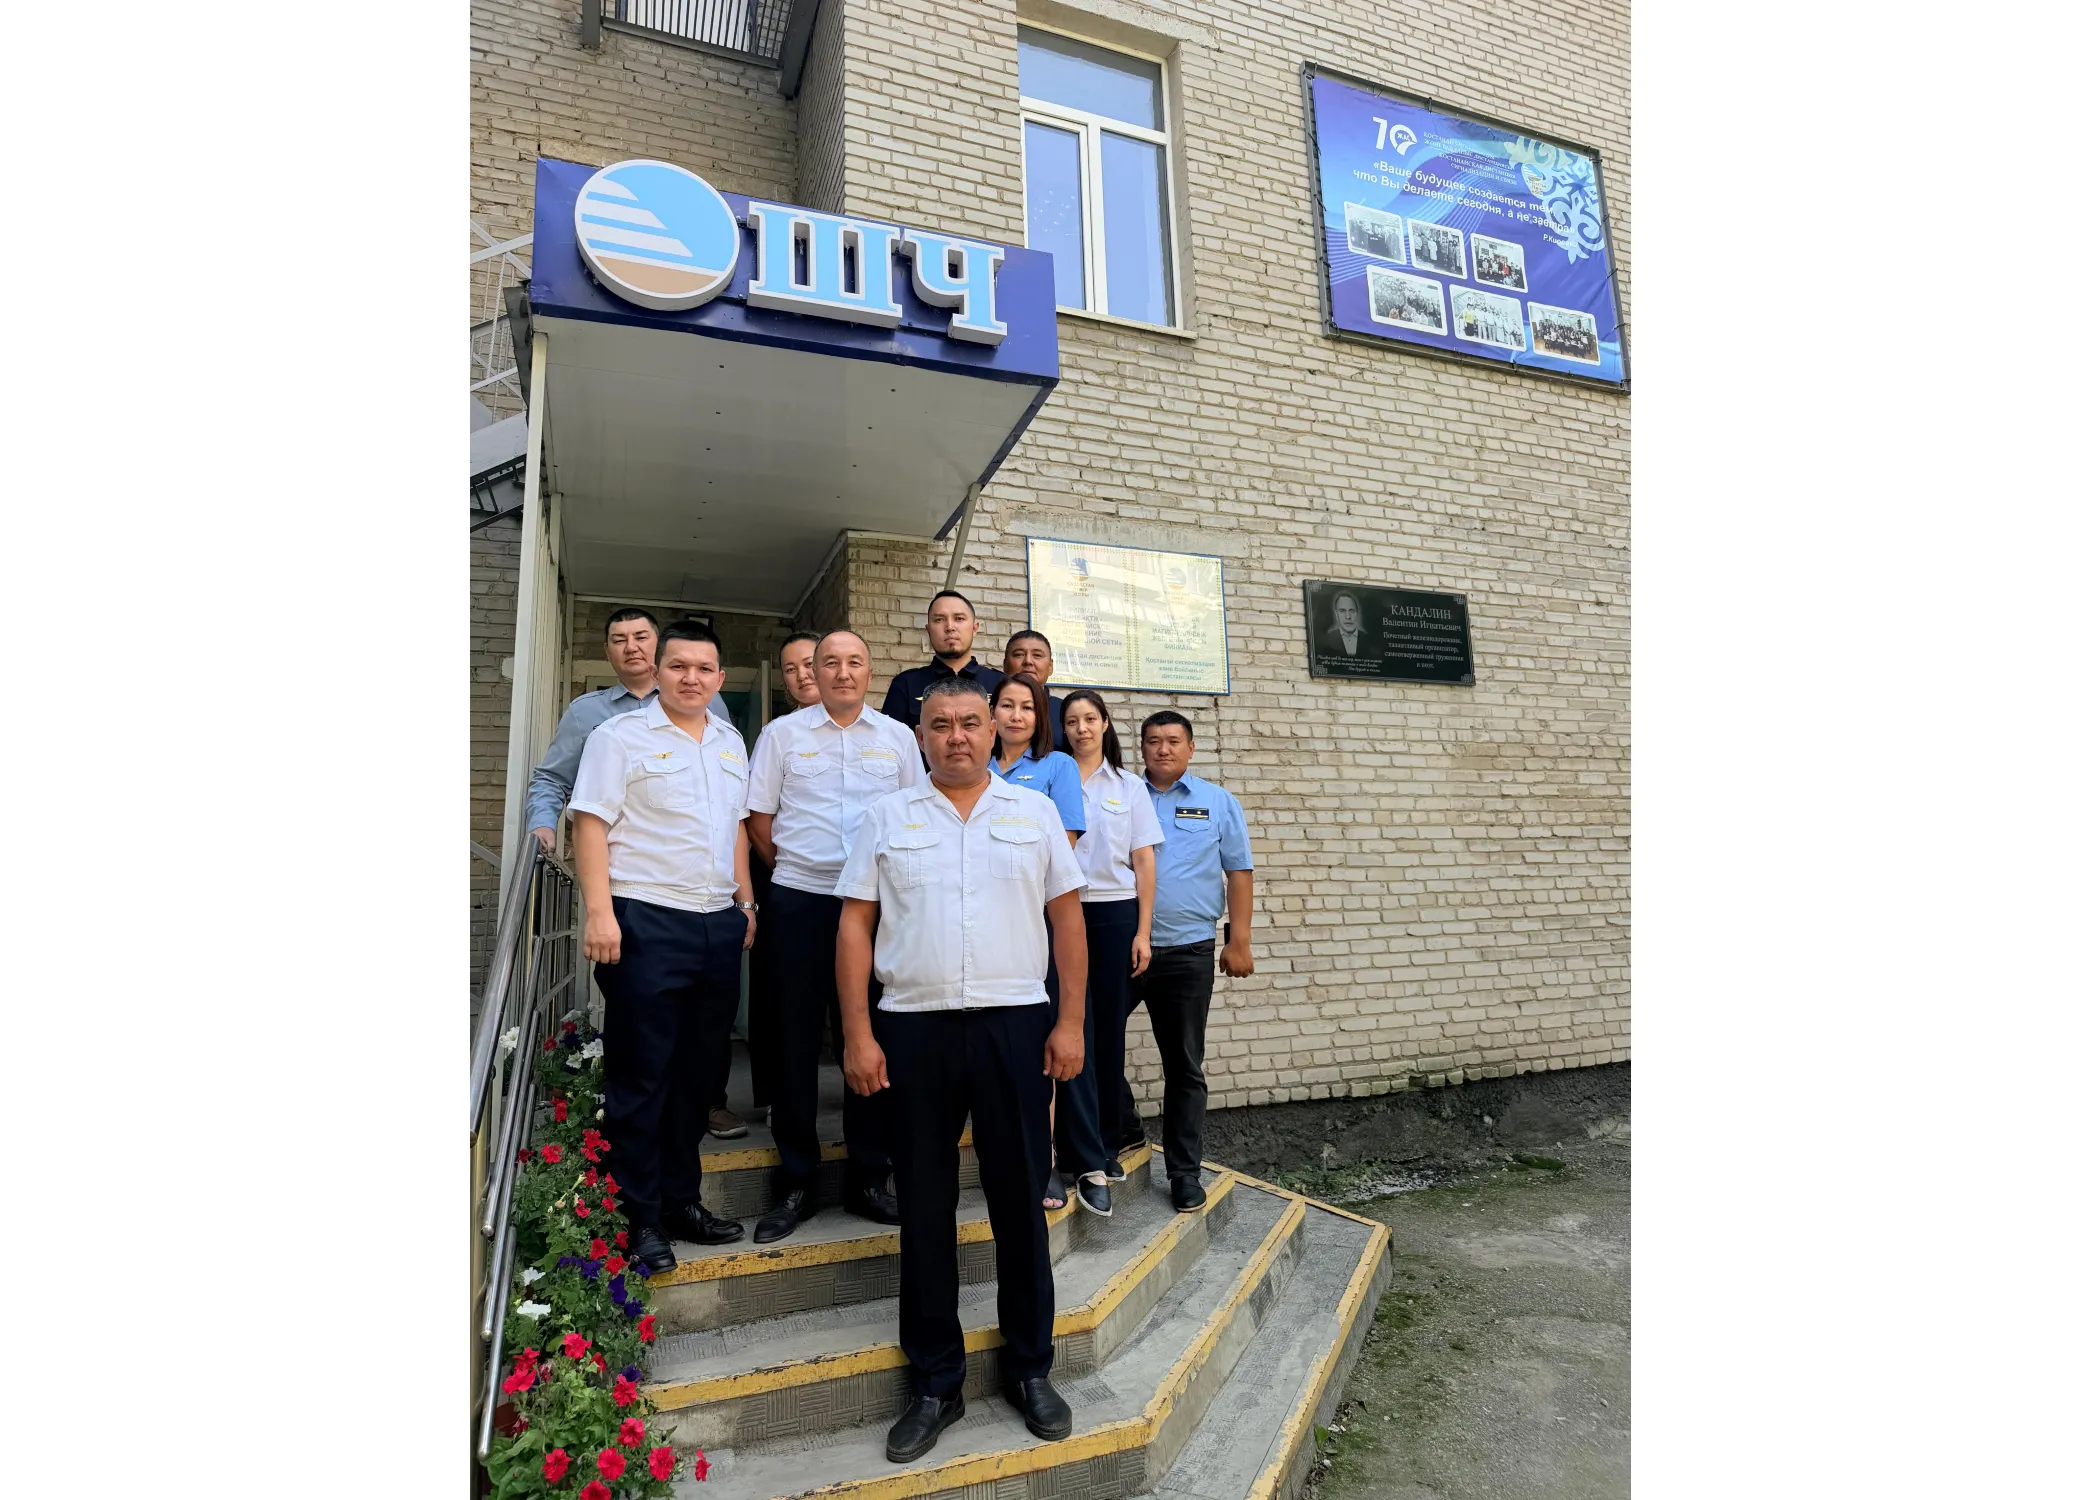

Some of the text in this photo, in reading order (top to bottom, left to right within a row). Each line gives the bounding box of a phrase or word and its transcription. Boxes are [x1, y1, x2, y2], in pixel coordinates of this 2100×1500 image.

[1352, 169, 1378, 184] что
[1381, 175, 1400, 189] Вы
[1402, 181, 1454, 203] делаете
[1456, 196, 1505, 218] сегодня,
[1507, 210, 1514, 218] а
[1516, 211, 1530, 222] не
[1373, 160, 1413, 178] «Ваше
[1415, 170, 1466, 191] будущее
[1468, 186, 1526, 209] создается
[748, 200, 1007, 346] ШЧ
[1382, 617, 1462, 632] Валентин Игнатьевич
[1391, 604, 1453, 620] КАНДАЛИН
